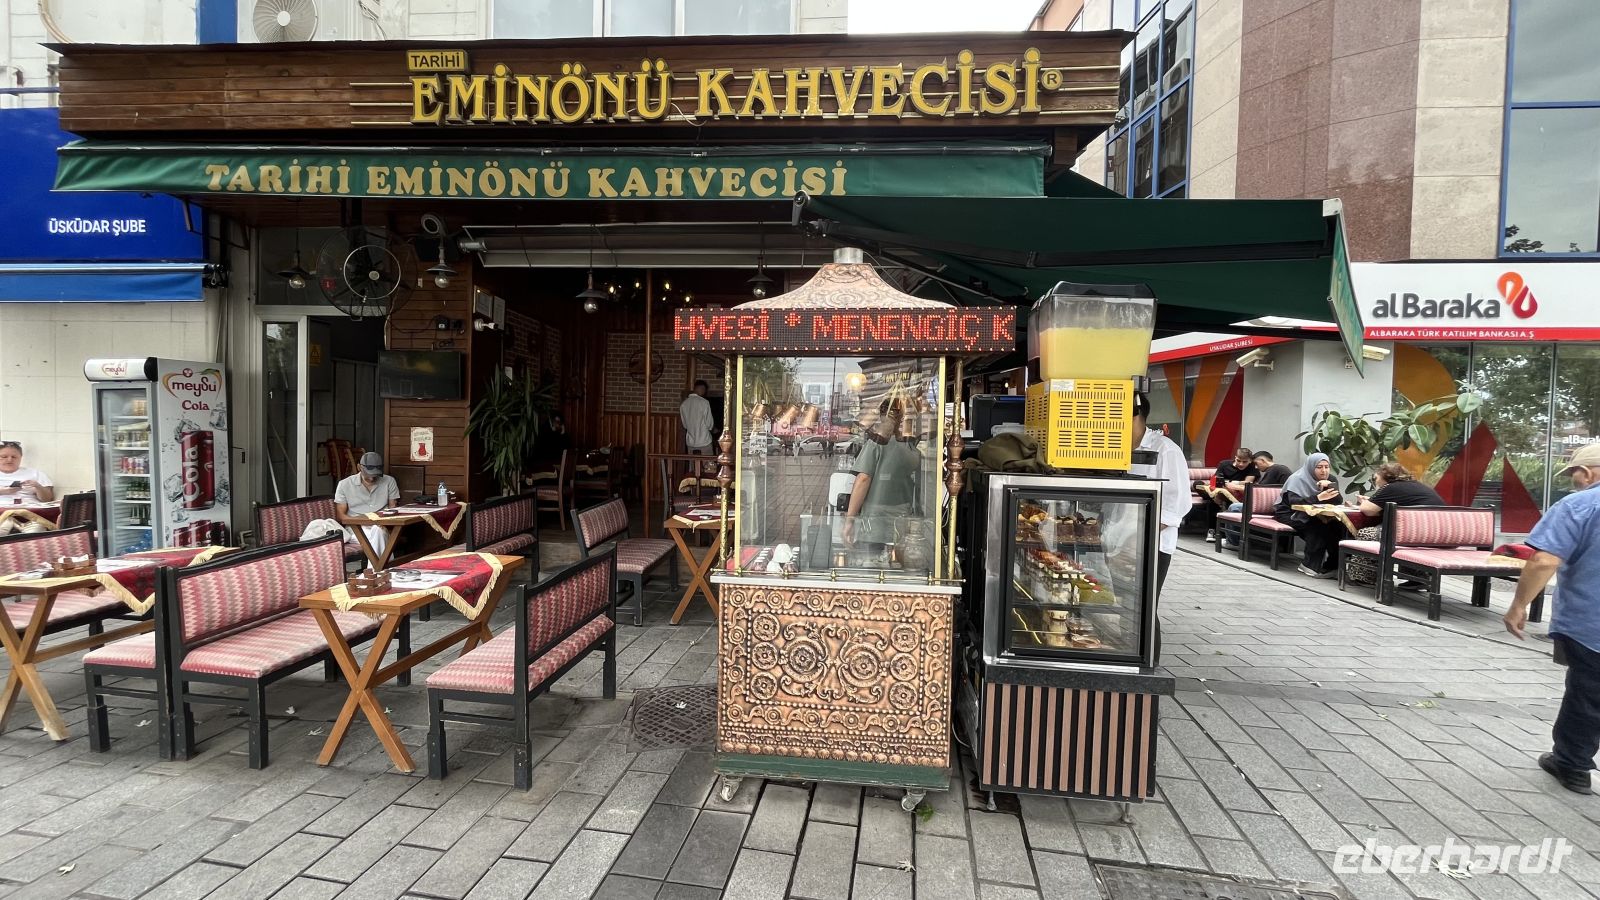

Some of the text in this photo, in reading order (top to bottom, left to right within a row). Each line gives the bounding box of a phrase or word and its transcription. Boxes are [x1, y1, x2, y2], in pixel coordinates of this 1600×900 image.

[411, 52, 461, 68] TARİHİ
[409, 59, 673, 125] EMİNÖNÜ
[695, 47, 1041, 117] KAHVECİSİ
[205, 158, 848, 198] TARİHİ EMİNÖNÜ KAHVECİSİ
[49, 217, 146, 236] ÜSKÜDAR ŞUBE
[1372, 292, 1501, 318] alBaraka
[812, 309, 982, 351] MENENGİÇ
[1369, 329, 1415, 337] ALBARAKA
[1417, 328, 1441, 338] TÜRK
[1442, 329, 1477, 338] KATILIM
[1478, 330, 1518, 338] BANKASI
[182, 400, 210, 411] Cola
[182, 445, 200, 503] Cola
